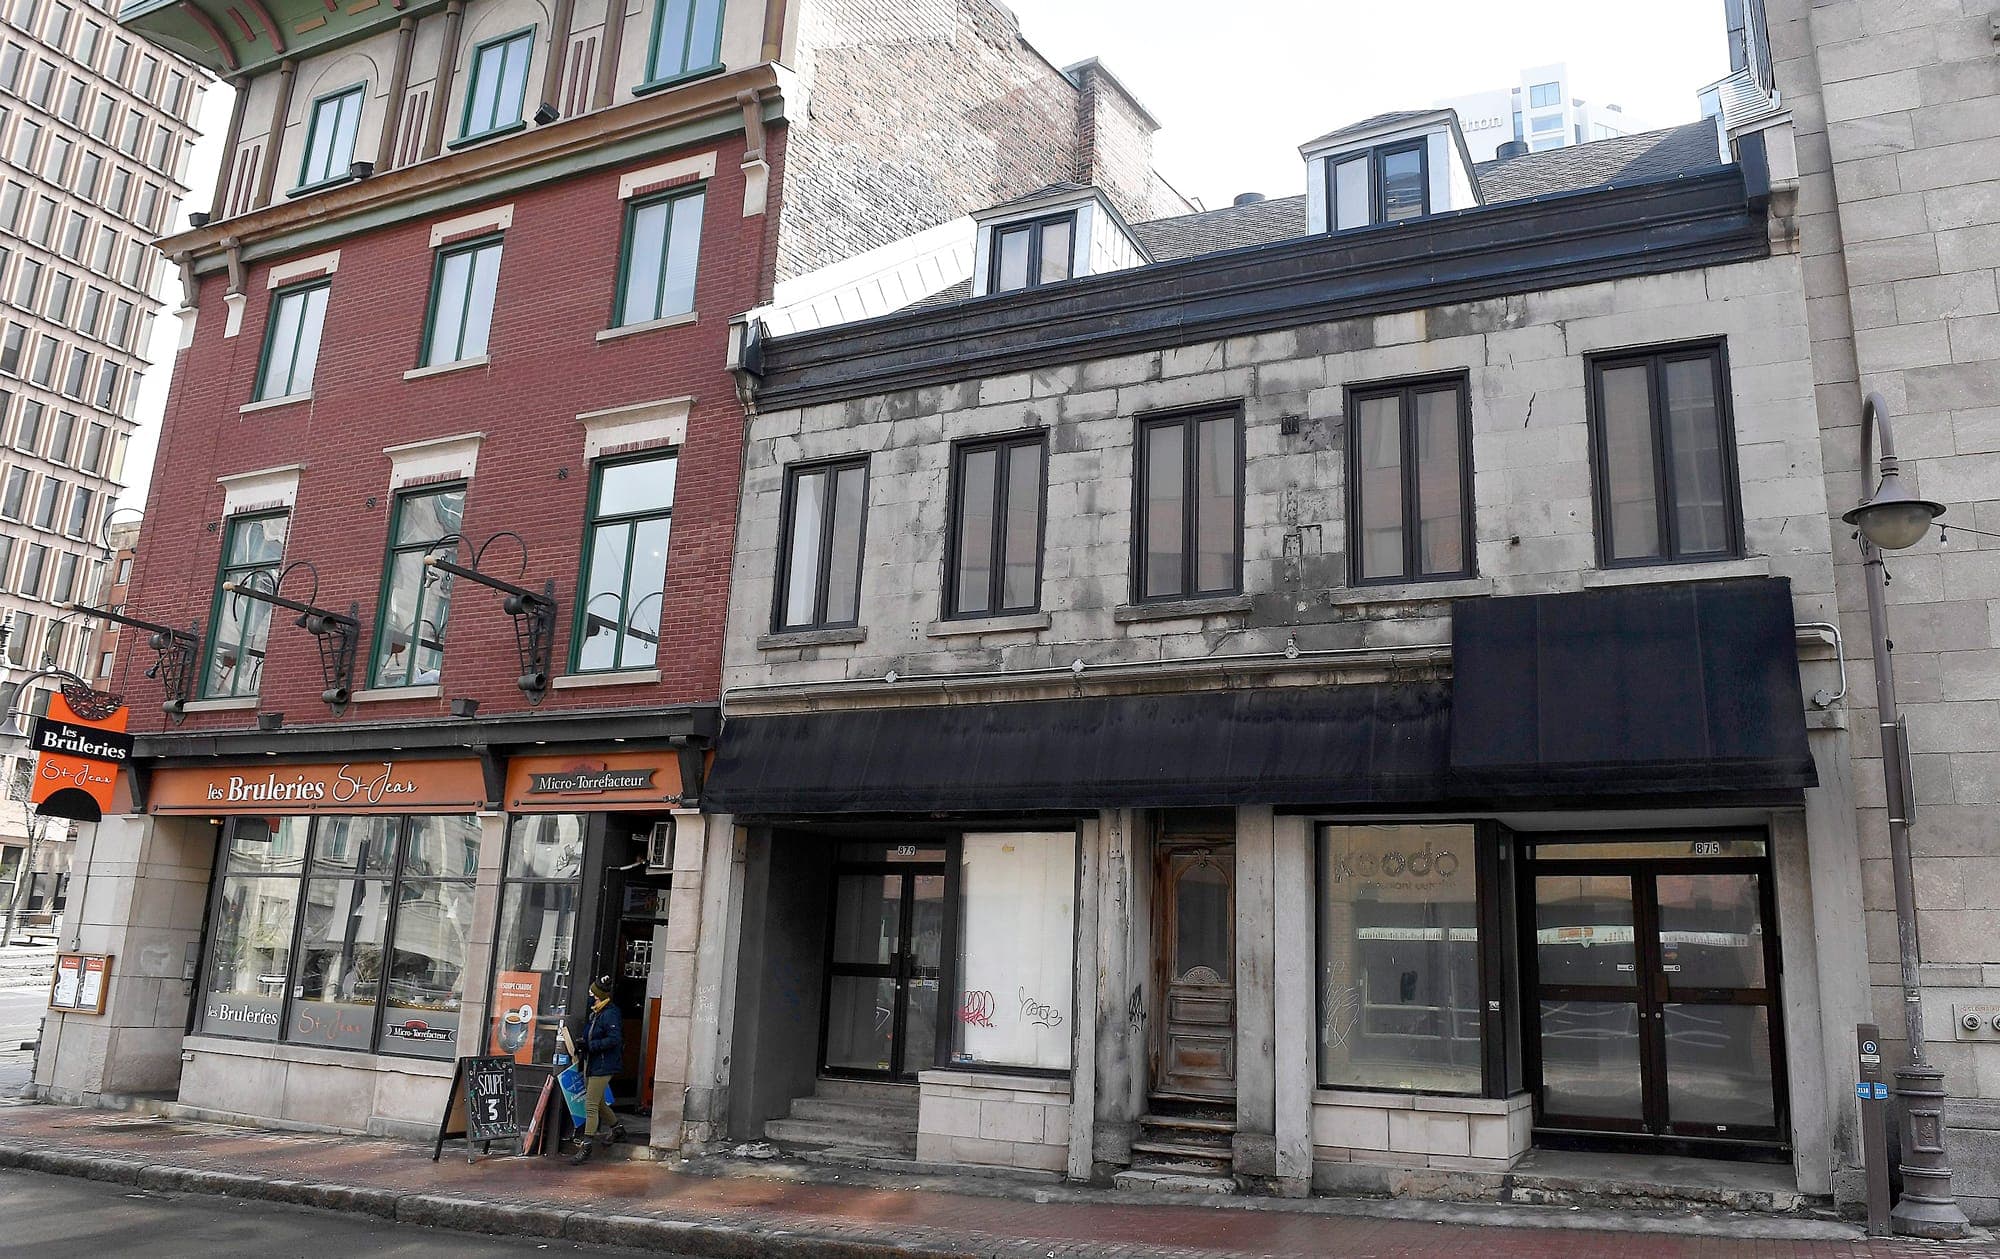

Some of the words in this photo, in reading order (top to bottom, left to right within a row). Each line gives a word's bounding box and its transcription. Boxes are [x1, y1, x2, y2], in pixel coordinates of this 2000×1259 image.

[62, 725, 78, 738] les
[42, 730, 127, 759] Bruleries
[42, 759, 112, 786] St-Jean
[207, 783, 224, 801] les
[226, 772, 326, 802] Bruleries
[332, 762, 419, 804] St-Jean
[898, 846, 916, 856] 879
[1696, 842, 1719, 854] 875
[207, 1005, 218, 1018] les
[219, 1004, 279, 1026] Bruleries
[478, 1073, 505, 1097] SOUPE
